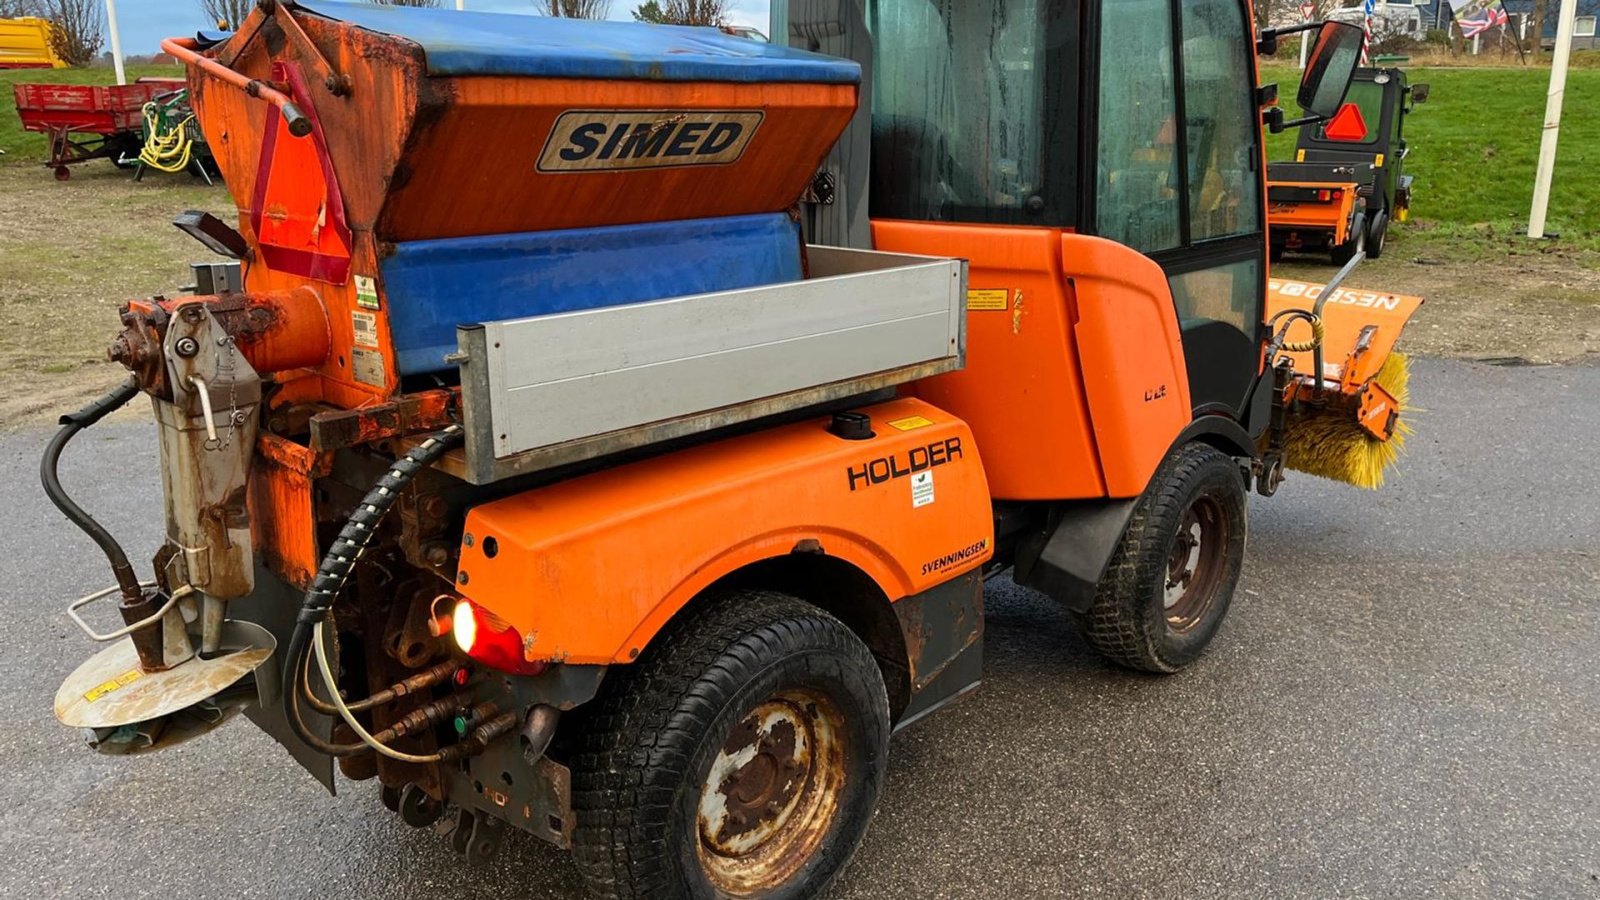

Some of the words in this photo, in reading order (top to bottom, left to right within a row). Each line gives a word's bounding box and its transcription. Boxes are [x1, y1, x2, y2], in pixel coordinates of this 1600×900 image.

[559, 122, 744, 162] SIMED
[847, 437, 962, 491] HOLDER
[921, 539, 986, 576] SVENNINGSEN
